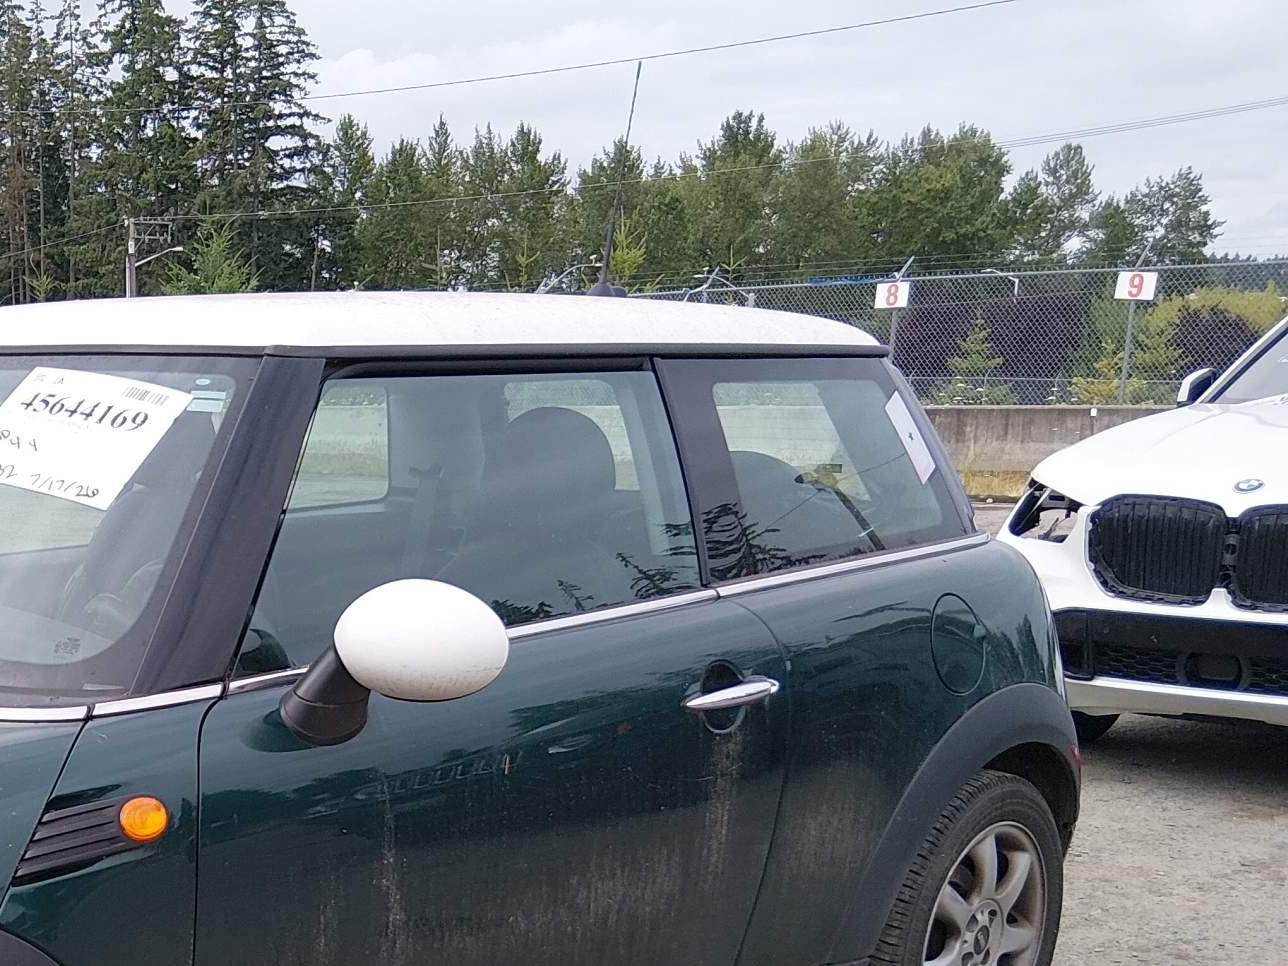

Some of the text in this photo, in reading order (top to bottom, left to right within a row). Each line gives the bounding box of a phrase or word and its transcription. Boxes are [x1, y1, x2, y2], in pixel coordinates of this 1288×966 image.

[886, 284, 899, 306] 8
[1128, 273, 1144, 298] 9
[20, 392, 149, 431] 45644169
[30, 473, 99, 497] 7/17/26
